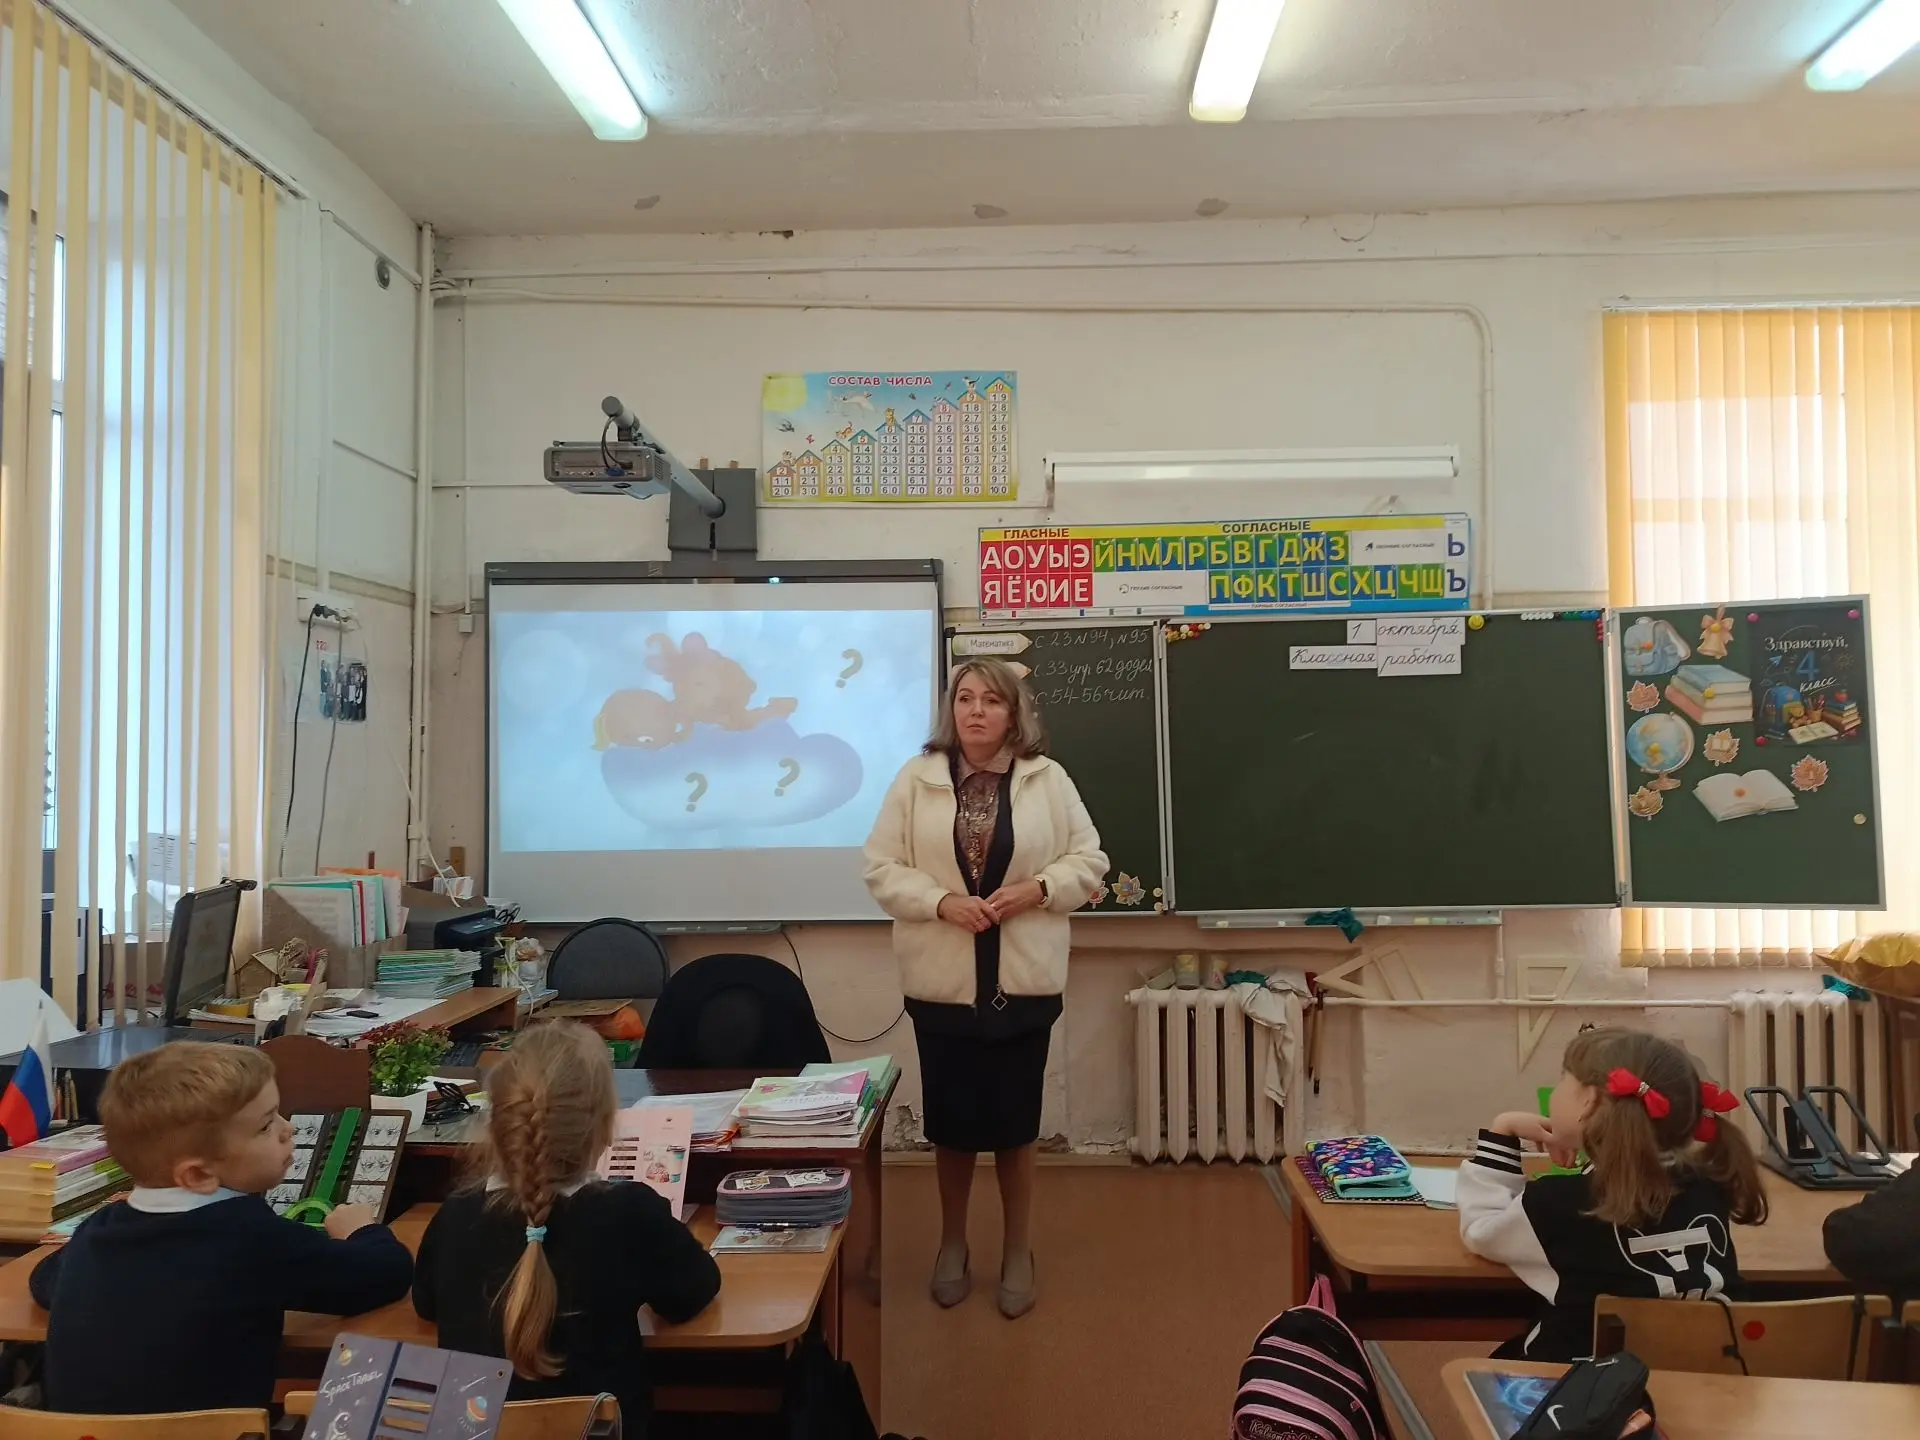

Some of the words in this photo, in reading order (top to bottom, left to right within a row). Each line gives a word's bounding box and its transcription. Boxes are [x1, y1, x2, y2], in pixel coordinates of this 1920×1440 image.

[828, 376, 880, 386] СОСТАВ
[886, 376, 932, 385] ЧИСЛА
[1003, 528, 1070, 540] ГЛАСНЫЕ
[1222, 521, 1311, 534] СОГЛАСНЫЕ
[1448, 533, 1466, 557] Ь
[1447, 568, 1466, 592] Ъ
[1050, 632, 1072, 646] 23
[1352, 622, 1362, 640] 1
[970, 640, 1014, 648] Математика
[1292, 648, 1376, 664] Классная
[1046, 660, 1068, 676] 33
[1096, 657, 1113, 675] 62
[1796, 650, 1820, 681] 4
[1800, 676, 1837, 693] класс
